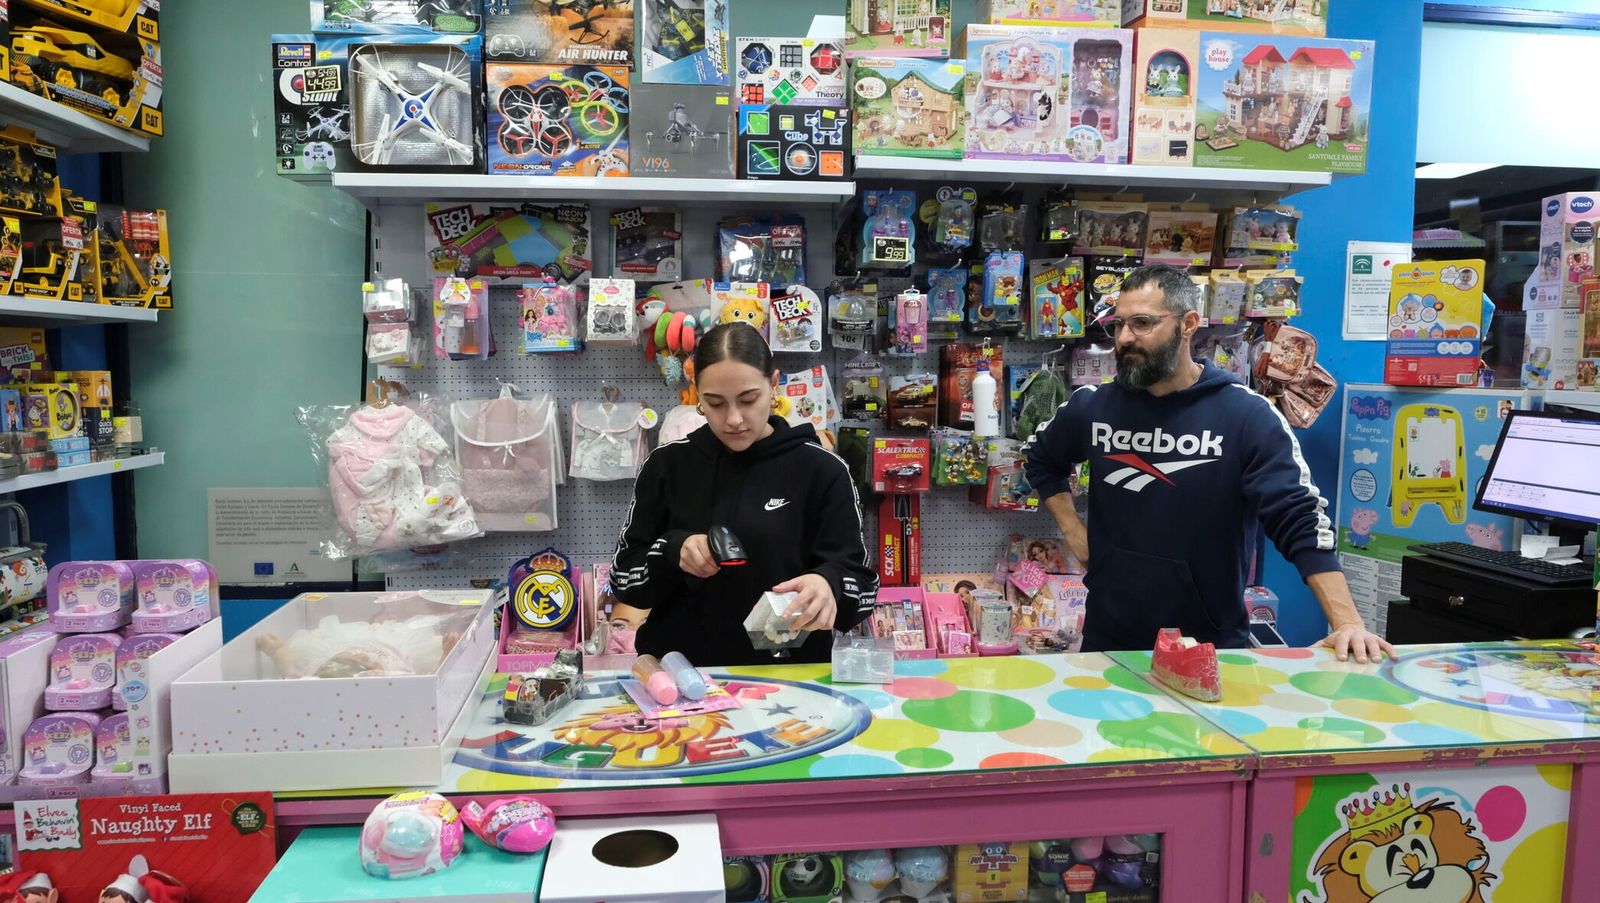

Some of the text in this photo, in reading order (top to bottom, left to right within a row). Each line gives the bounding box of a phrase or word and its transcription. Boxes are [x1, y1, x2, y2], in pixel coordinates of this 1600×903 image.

[141, 22, 154, 34] CAT
[279, 47, 304, 57] Revell
[558, 50, 628, 61] AIR HUNTER
[1211, 48, 1227, 57] play
[278, 59, 312, 68] Control
[1208, 54, 1230, 63] house
[815, 91, 845, 100] Theory
[145, 112, 159, 126] CAT
[432, 208, 469, 228] TECH
[614, 209, 640, 221] TECH
[619, 217, 646, 230] DECK
[441, 219, 477, 241] DECK
[1096, 265, 1130, 273] BEYBLADE
[773, 296, 800, 313] TECH
[779, 306, 808, 320] DECK
[0, 346, 28, 359] BRICK
[12, 353, 34, 363] THIS!
[1351, 399, 1391, 417] Peppa Pig
[98, 427, 113, 435] STOP
[1091, 422, 1224, 457] Reebok
[877, 446, 920, 454] SCALEXTRIC
[885, 556, 894, 577] SCX
[1059, 589, 1087, 601] Letterin
[37, 806, 69, 818] Elves
[119, 802, 182, 814] Vinyl Faced
[36, 813, 75, 828] Behavin'
[91, 813, 212, 836] Naughty Elf
[50, 825, 78, 840] Badly
